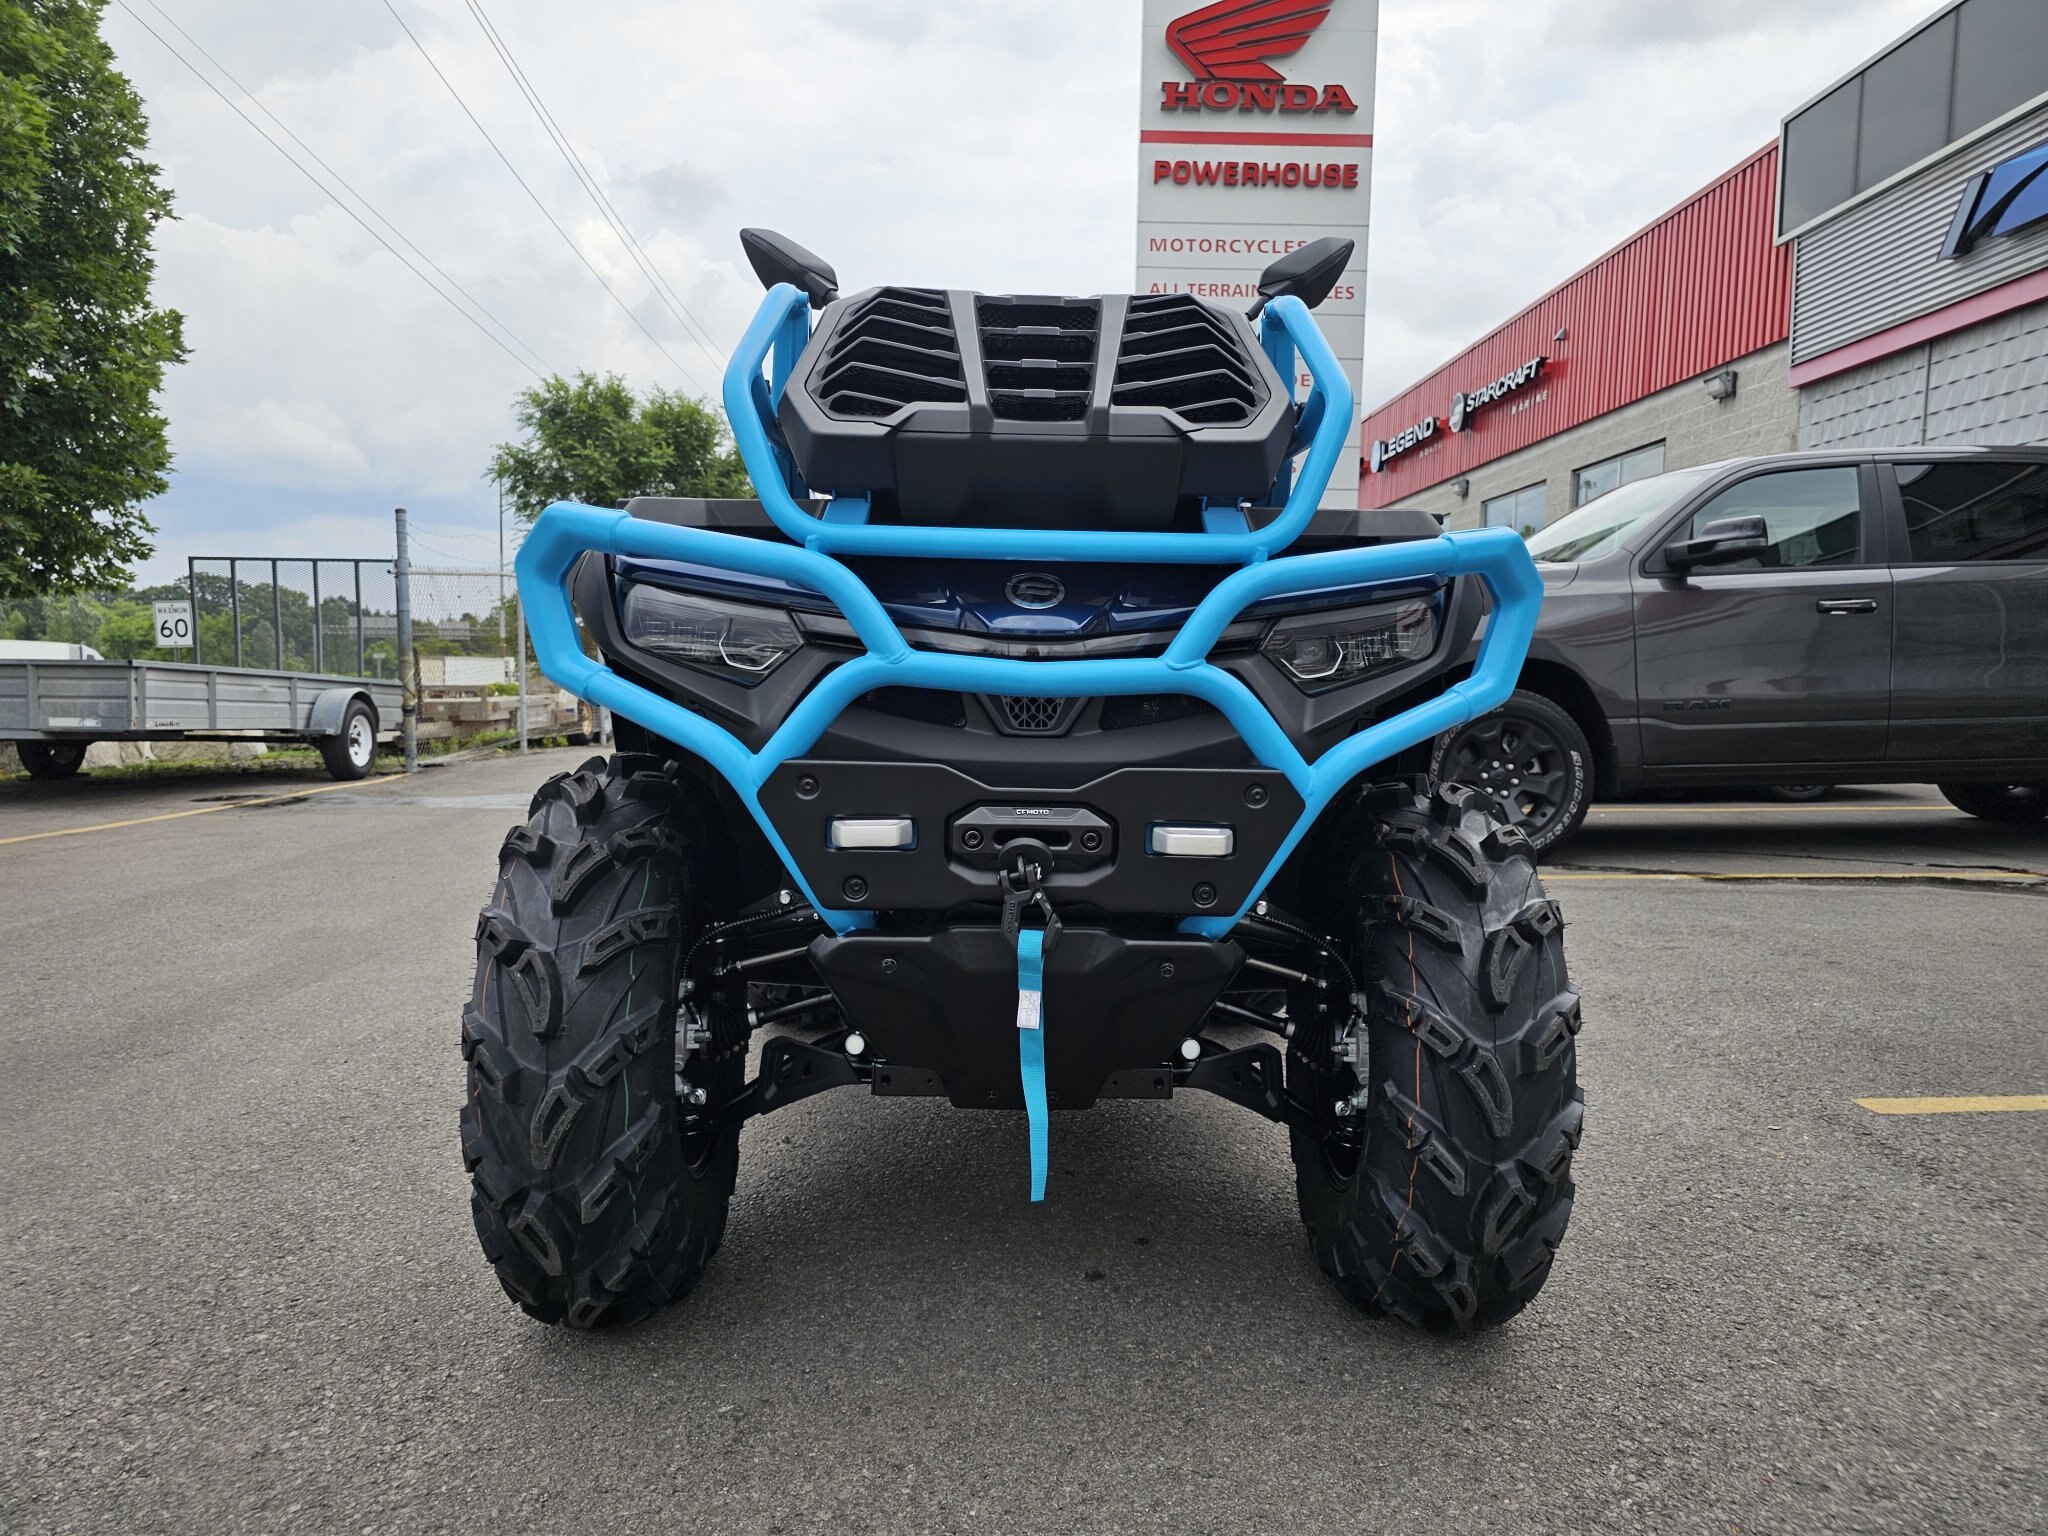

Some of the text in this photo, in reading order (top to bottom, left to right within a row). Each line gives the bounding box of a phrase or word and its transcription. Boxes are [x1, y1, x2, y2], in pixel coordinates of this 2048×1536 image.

[1160, 82, 1358, 114] HONDA
[1154, 160, 1359, 189] POWERHOUSE
[1465, 357, 1542, 413] STARCRAFT
[1381, 416, 1435, 462] LEGEND
[157, 606, 188, 614] MAXIMUM
[160, 618, 188, 638] 60
[1663, 698, 1732, 711] RAM
